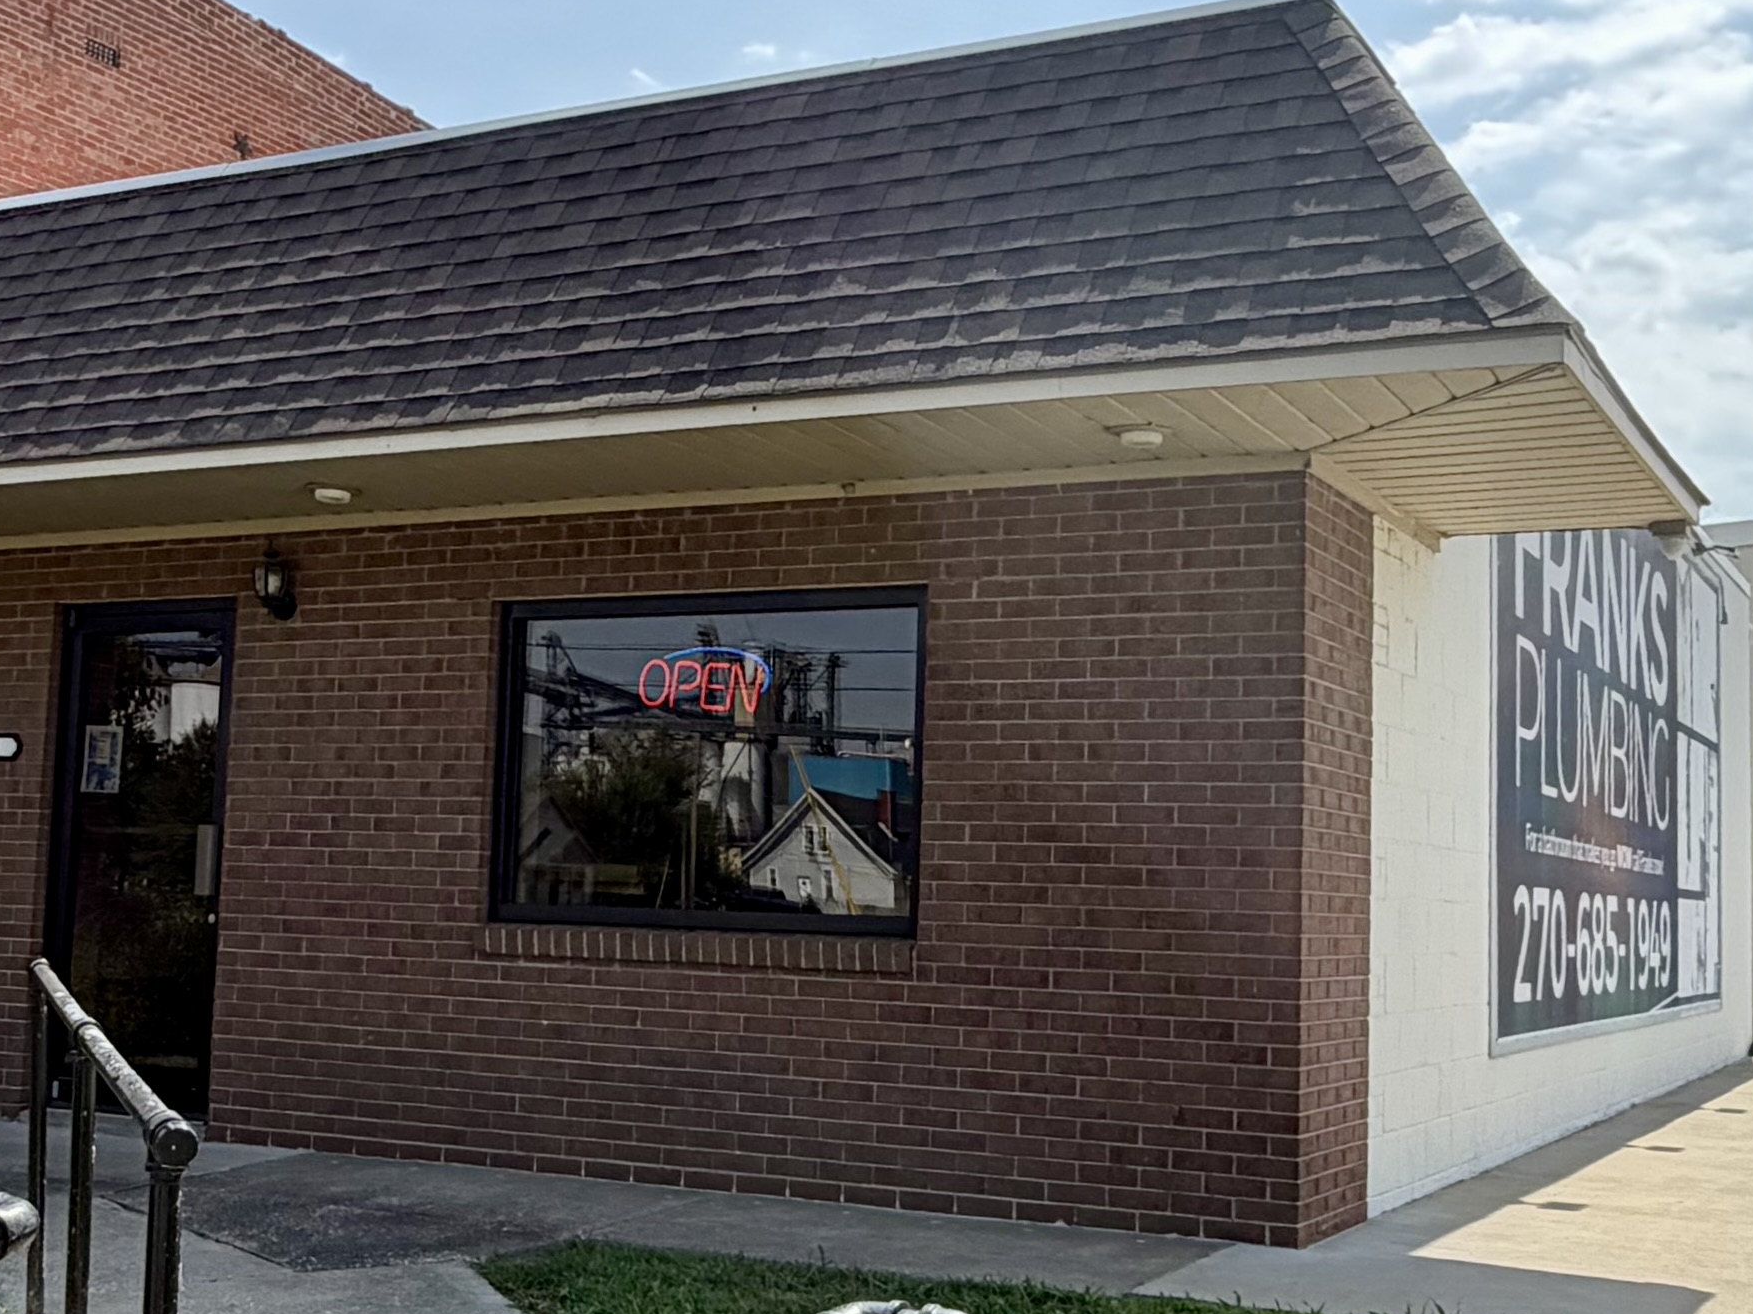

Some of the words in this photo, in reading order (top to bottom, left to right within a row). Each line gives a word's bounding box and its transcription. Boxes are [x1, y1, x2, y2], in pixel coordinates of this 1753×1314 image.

[638, 658, 764, 714] OPEN
[1516, 633, 1670, 831] PLUMBING
[1511, 884, 1672, 1004] 270-685-1949
